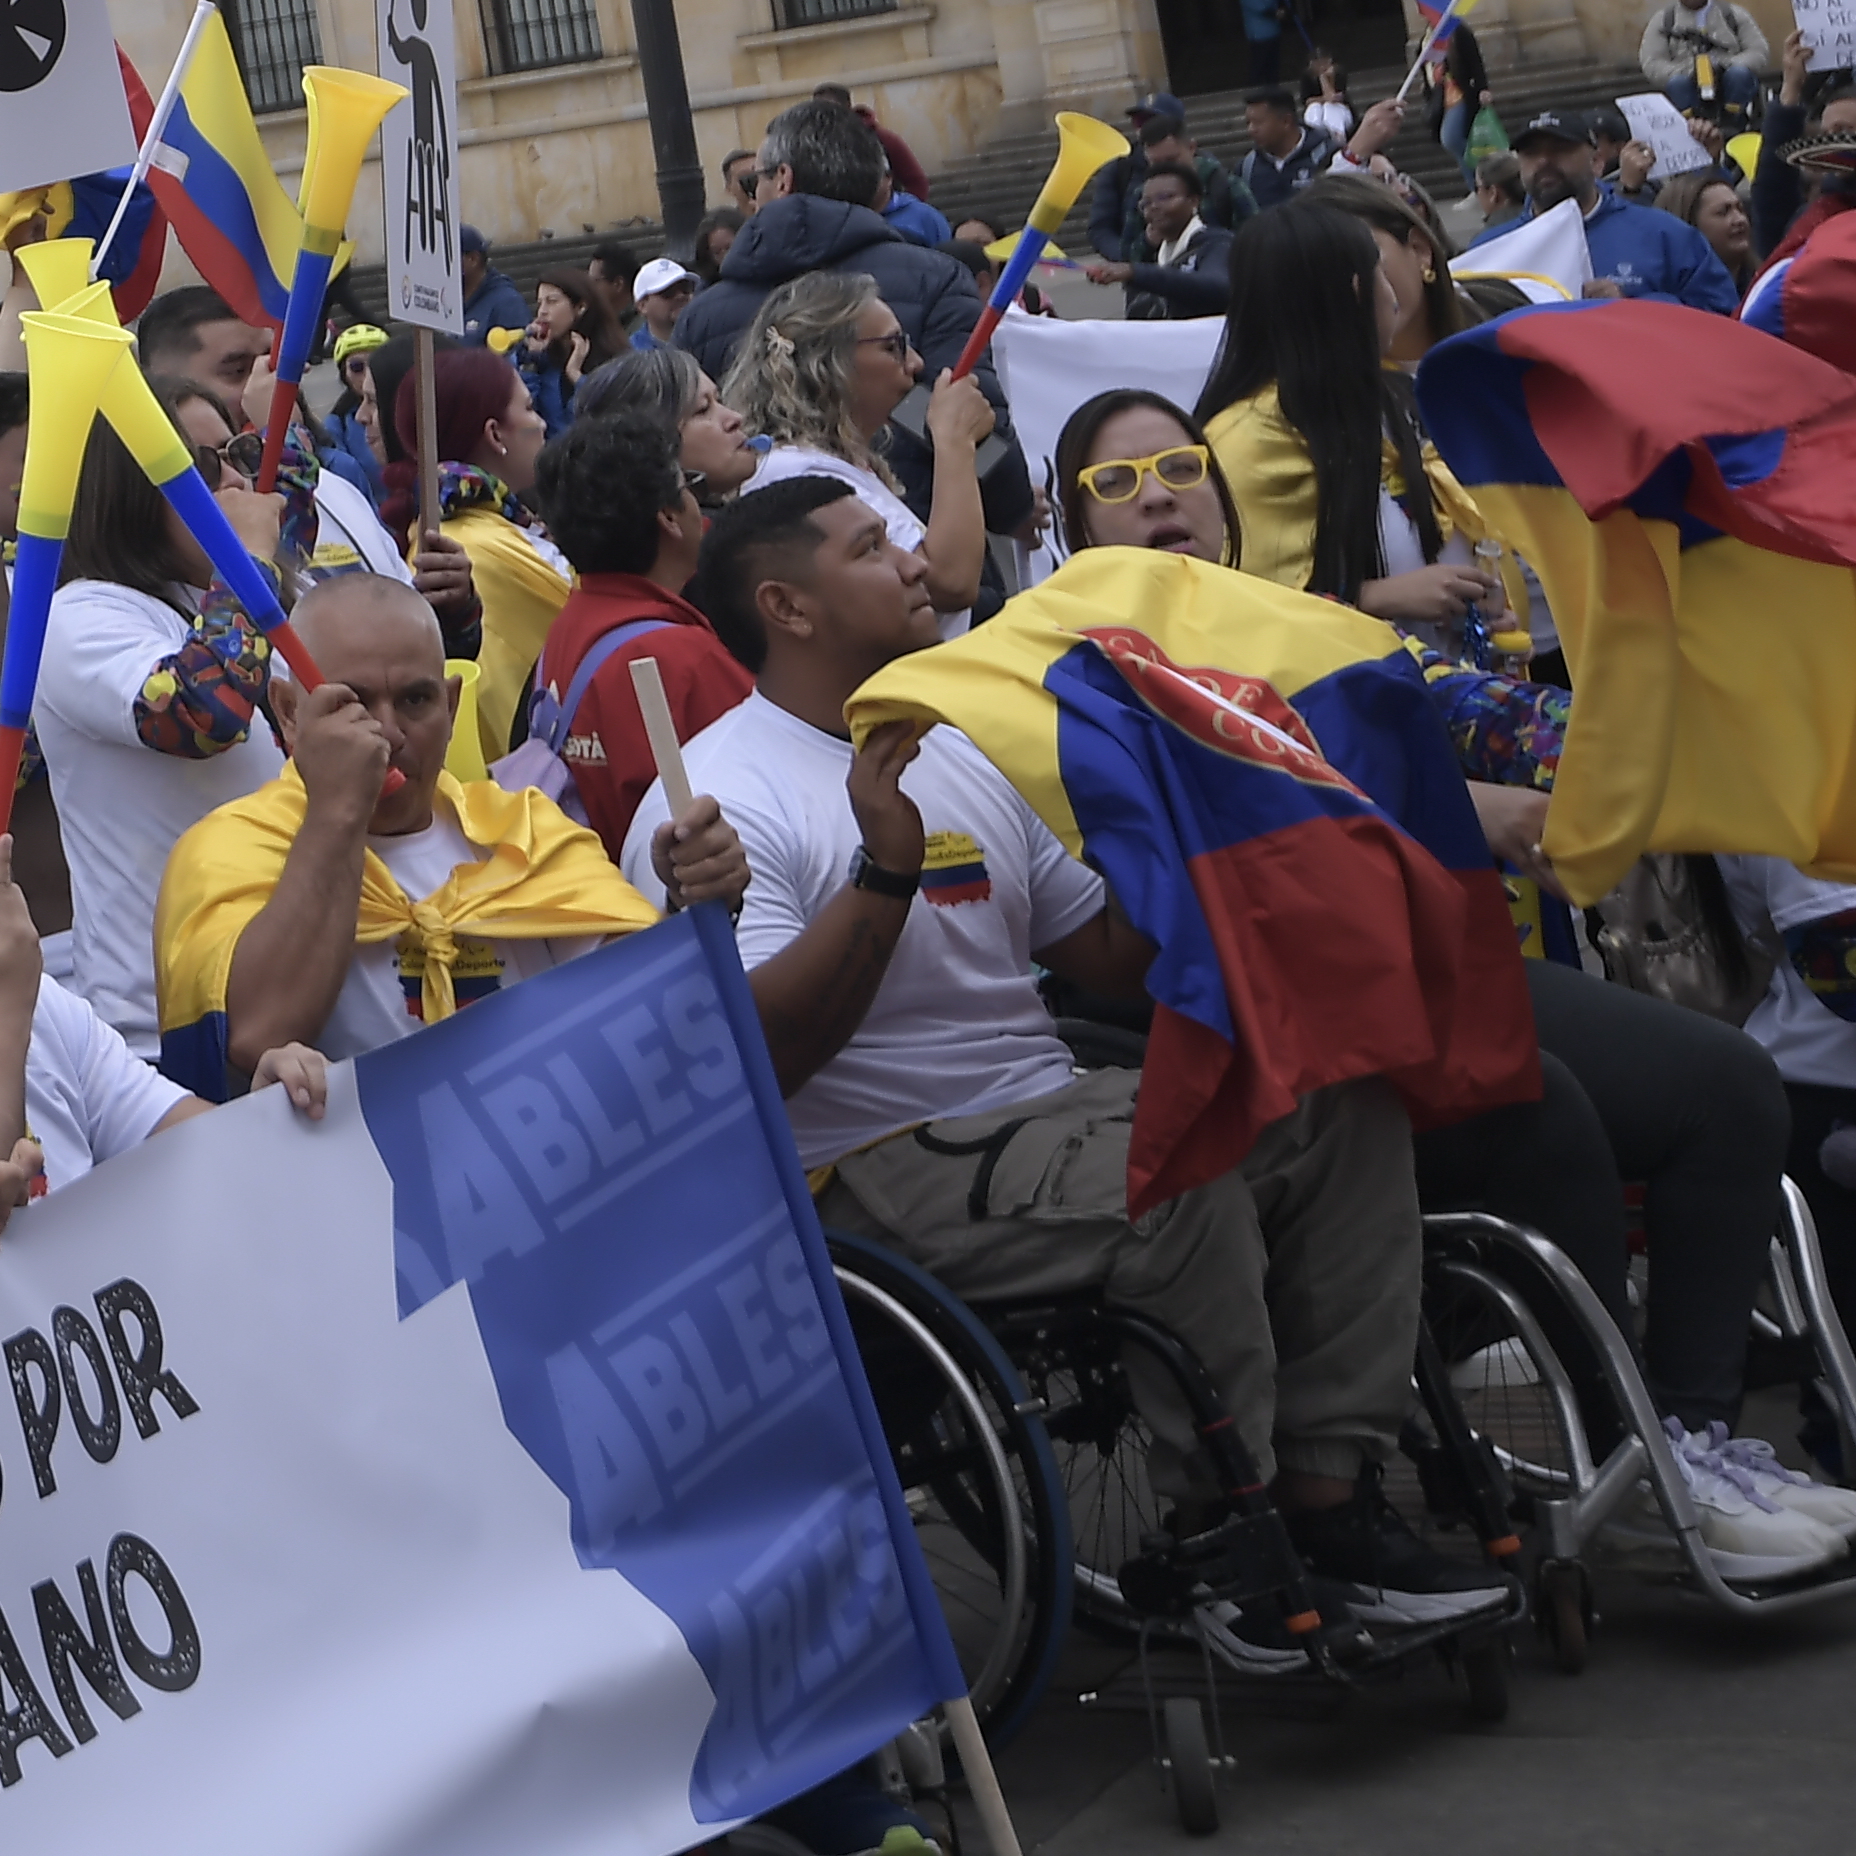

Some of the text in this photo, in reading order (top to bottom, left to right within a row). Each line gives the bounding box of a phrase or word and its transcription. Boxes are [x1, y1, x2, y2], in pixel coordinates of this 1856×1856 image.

[418, 970, 742, 1287] ABLES
[2, 1276, 201, 1499] POR
[545, 1220, 835, 1558] ABLES
